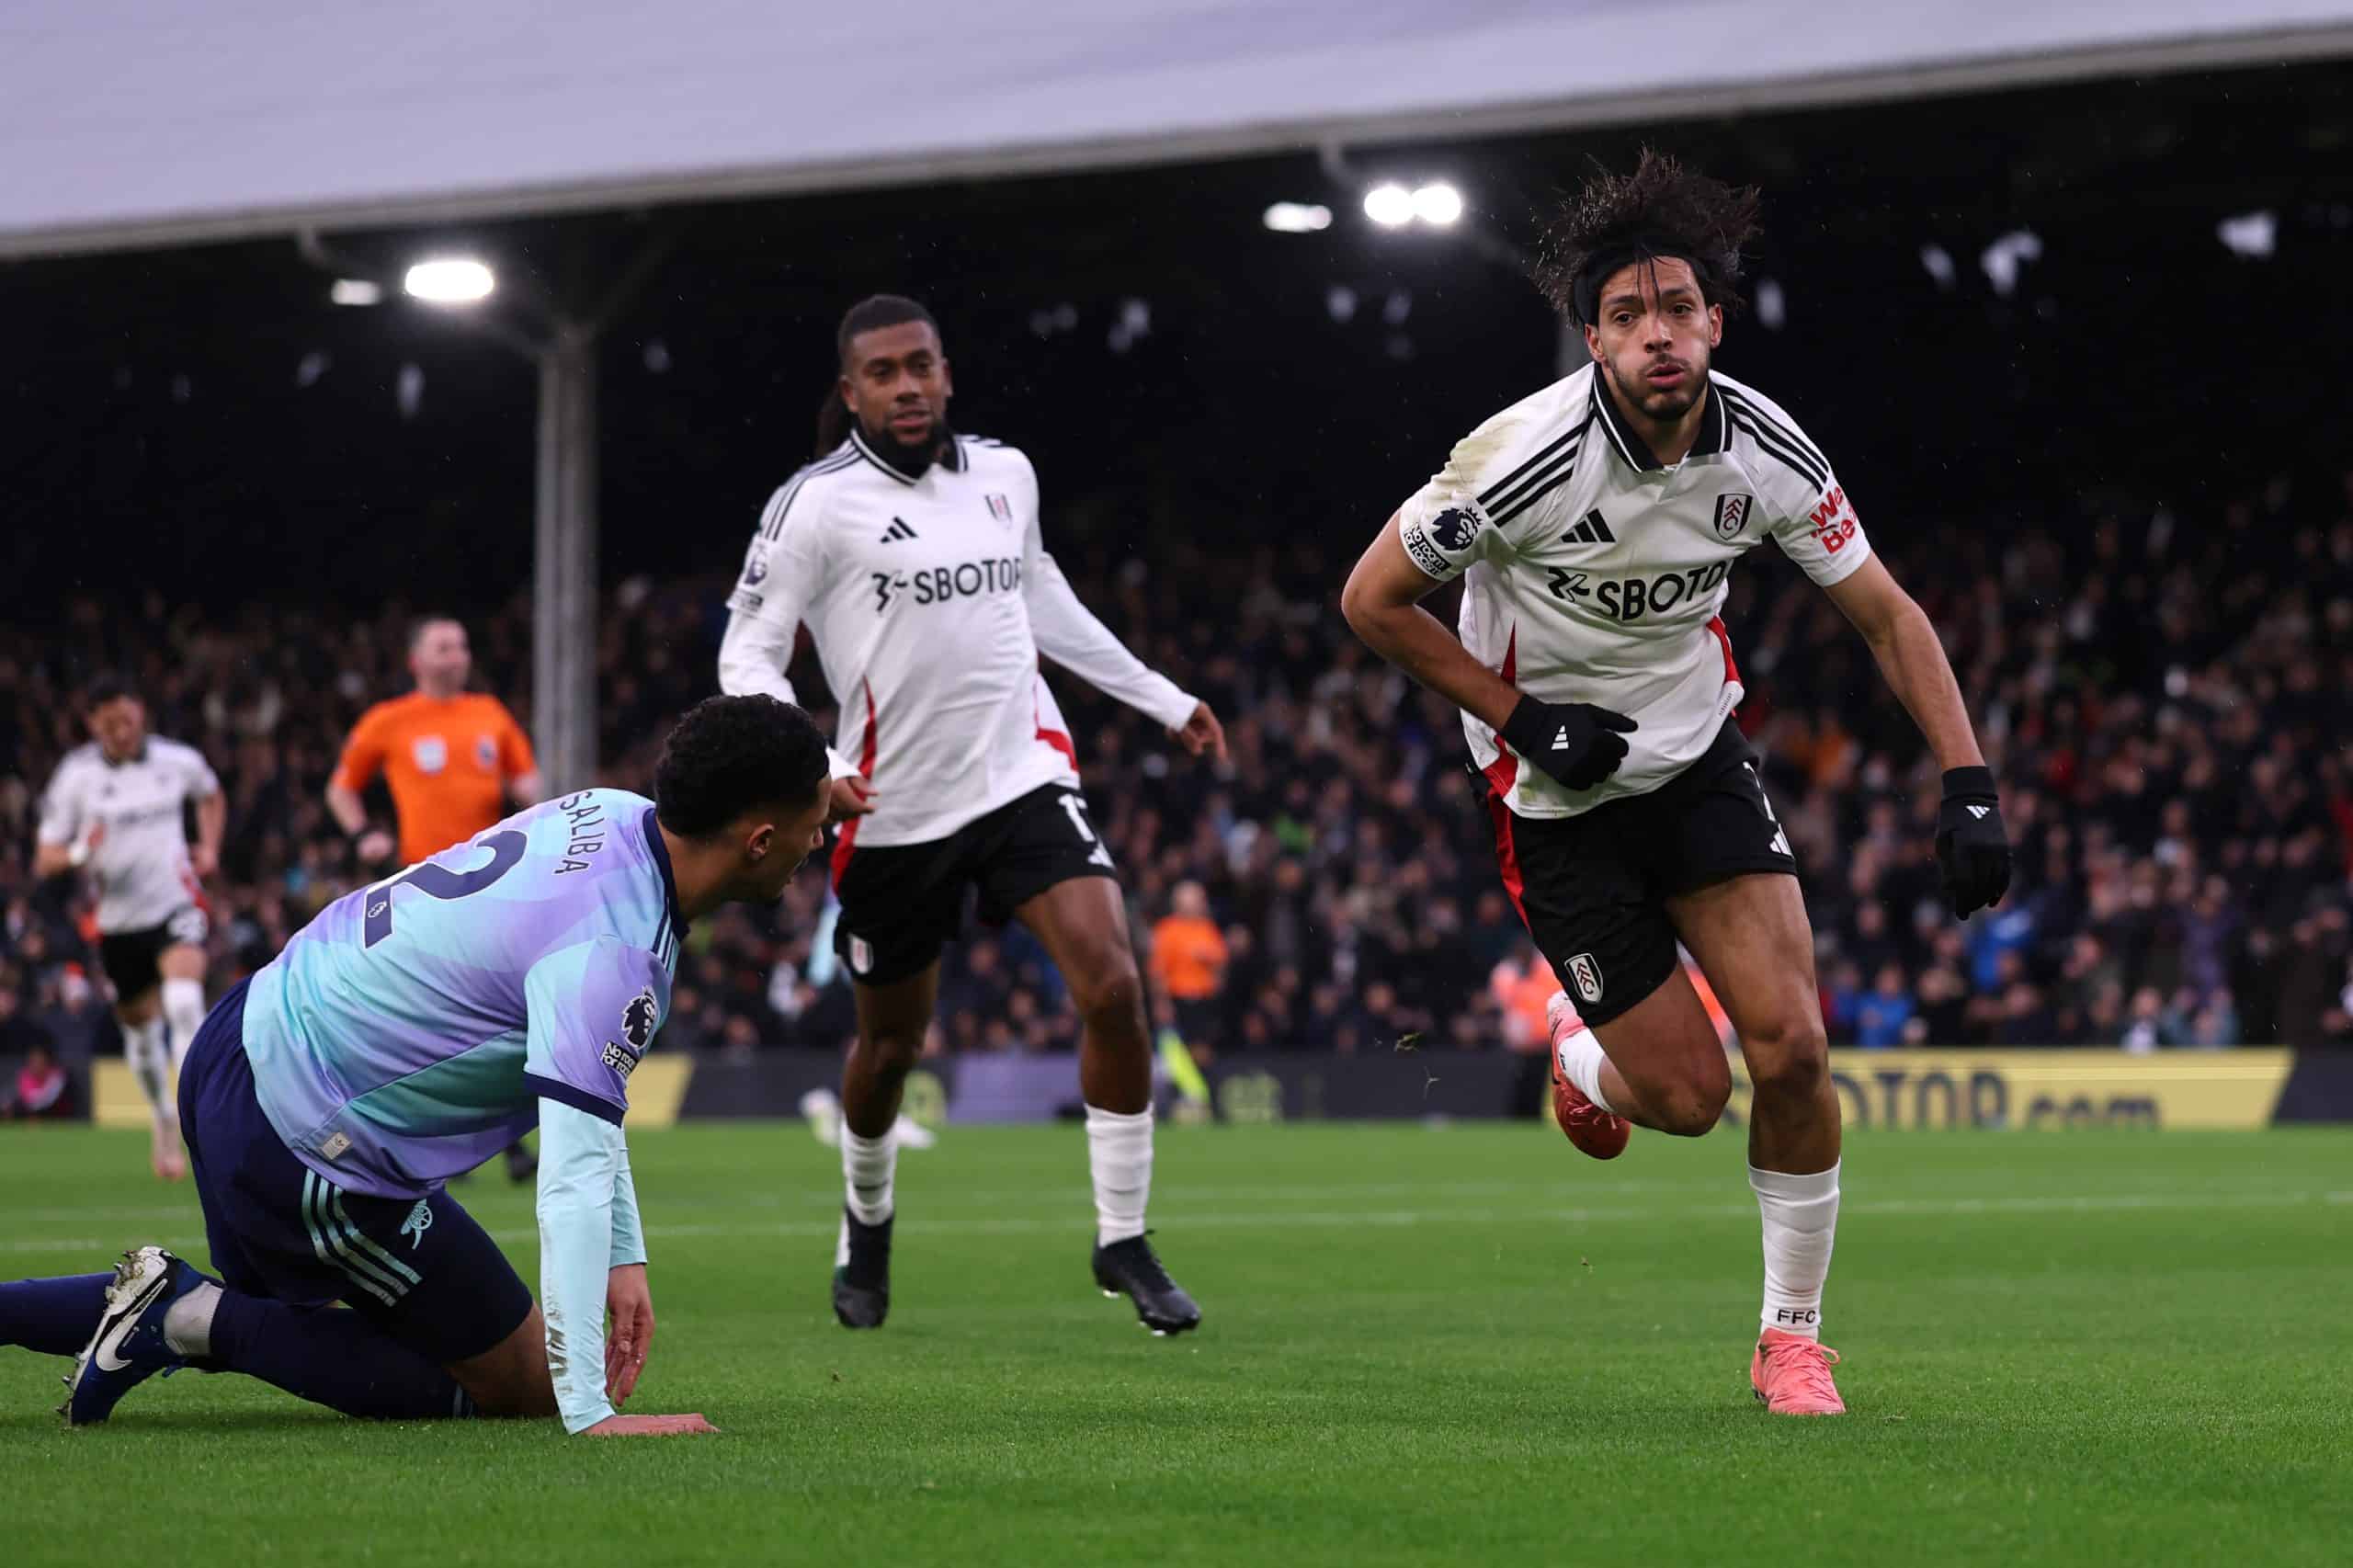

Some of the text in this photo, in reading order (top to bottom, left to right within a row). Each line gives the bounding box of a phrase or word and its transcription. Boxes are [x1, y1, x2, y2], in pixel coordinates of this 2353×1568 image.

[553, 790, 606, 874] SALIBA
[364, 829, 529, 949] 2
[604, 1041, 622, 1059] No
[1777, 1309, 1816, 1324] FFC
